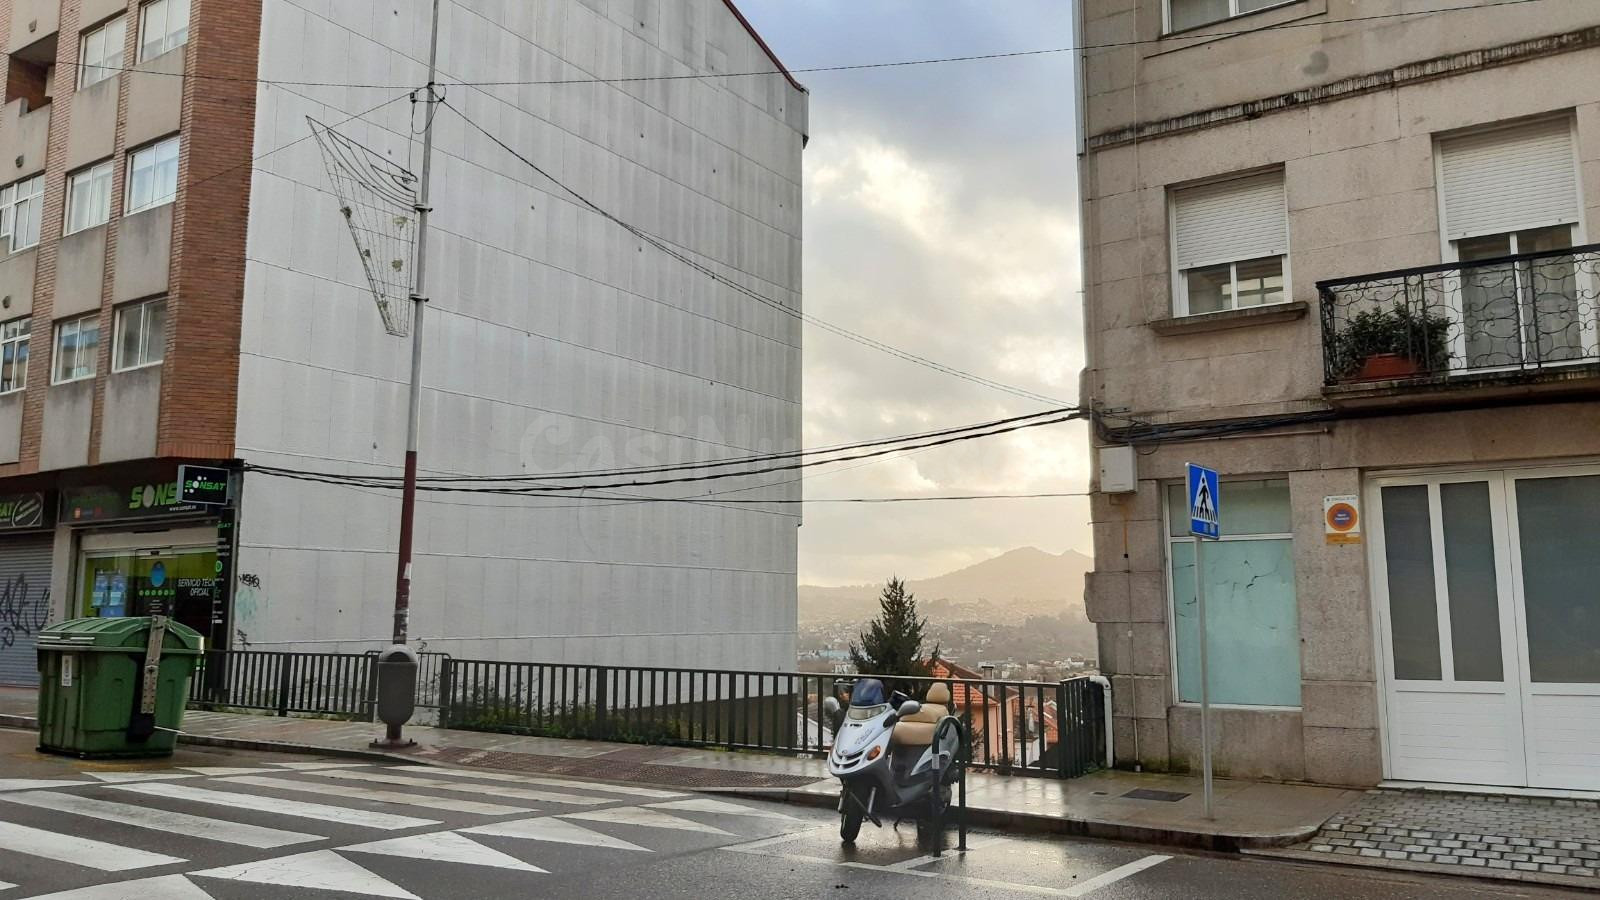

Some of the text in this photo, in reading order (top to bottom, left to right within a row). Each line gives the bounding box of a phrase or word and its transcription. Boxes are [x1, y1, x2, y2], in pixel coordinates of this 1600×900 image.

[185, 480, 226, 491] SONSAT
[129, 482, 178, 508] SONS
[0, 502, 14, 516] AT
[190, 587, 209, 596] OFICIAL
